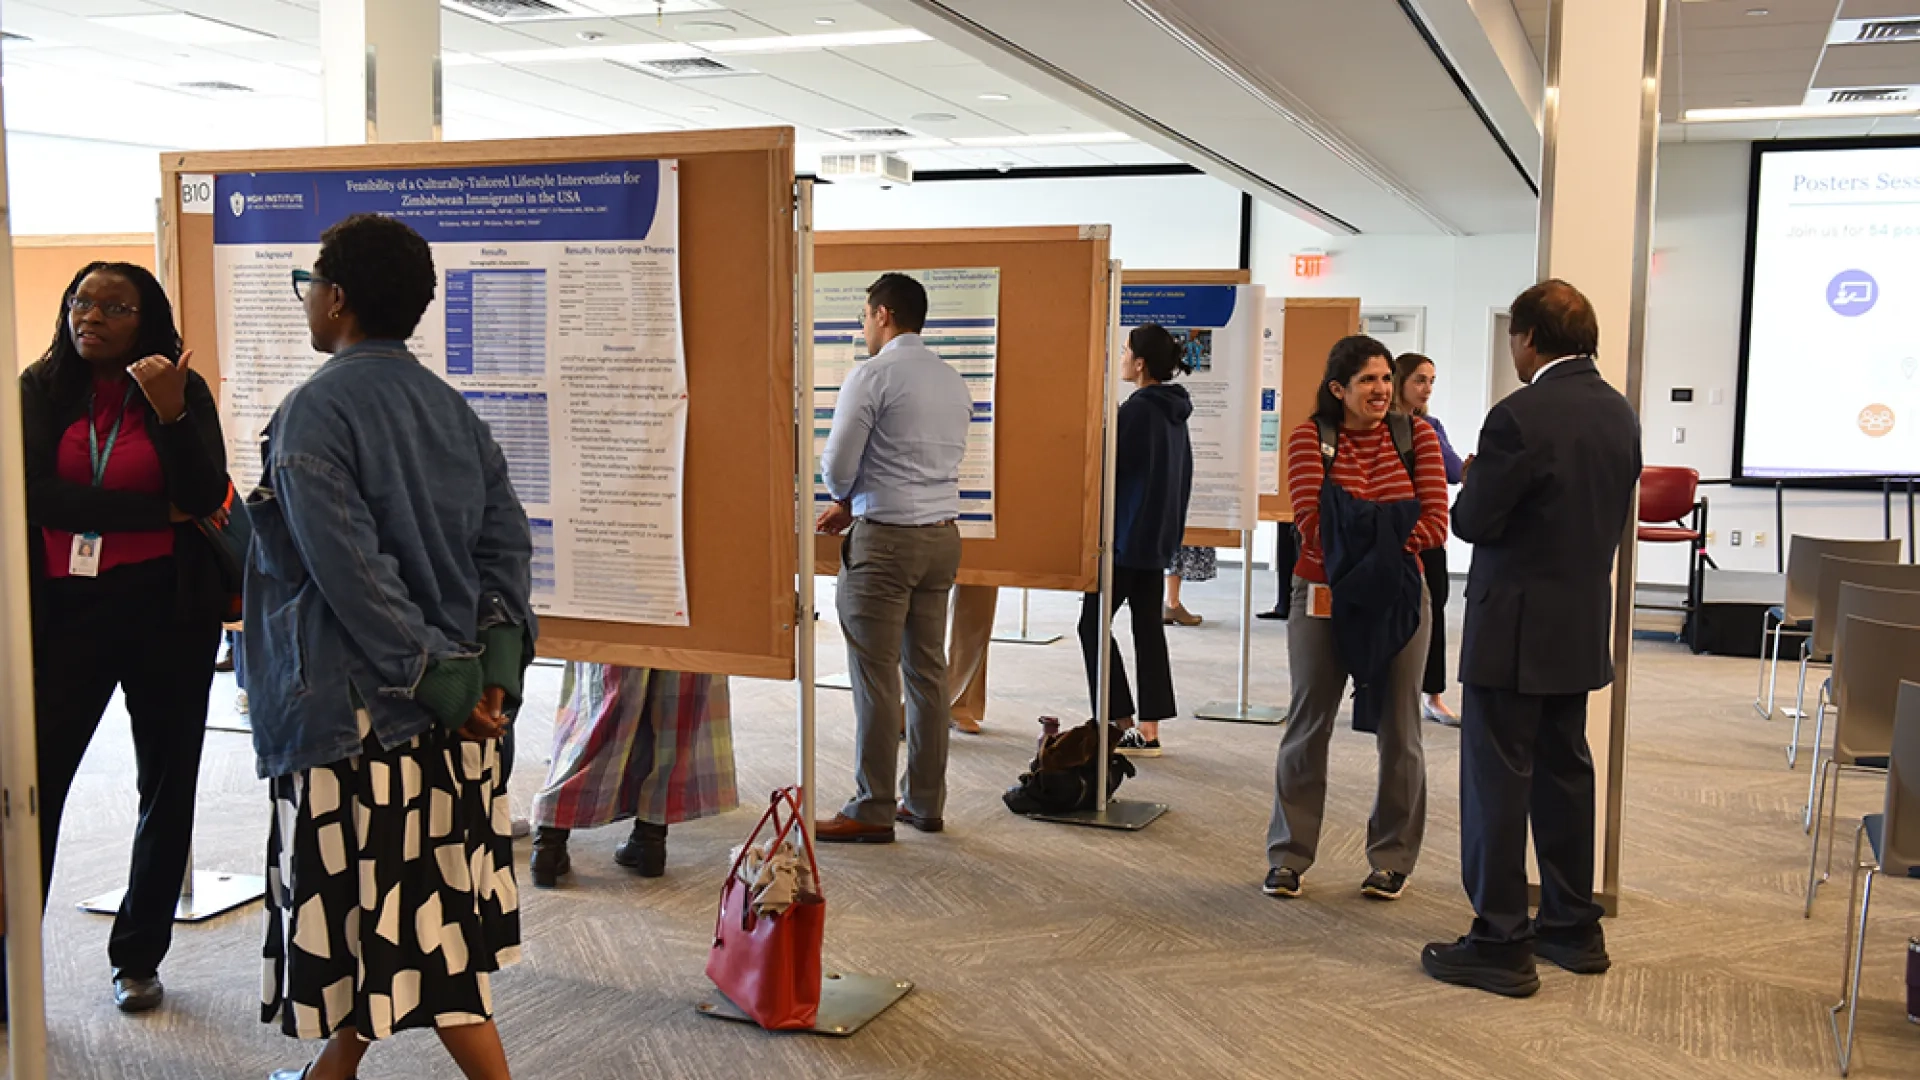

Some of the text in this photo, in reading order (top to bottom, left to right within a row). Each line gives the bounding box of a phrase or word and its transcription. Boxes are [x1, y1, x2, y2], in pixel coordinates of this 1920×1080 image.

[346, 179, 394, 193] Feasibility
[397, 178, 408, 190] of
[409, 181, 416, 190] a
[512, 174, 556, 190] Lifestyle
[557, 172, 621, 187] Intervention
[623, 170, 641, 185] for
[1793, 174, 1870, 192] Posters
[182, 182, 211, 204] B10
[401, 190, 581, 207] Zimbabwean Immigrants in the USA
[1787, 223, 1818, 239] Join
[1823, 225, 1839, 238] us
[1844, 224, 1864, 238] for
[1869, 223, 1889, 236] 54
[480, 248, 508, 257] Results
[595, 246, 616, 255] Focus
[618, 246, 642, 256] Group
[1296, 255, 1322, 276] EXIT
